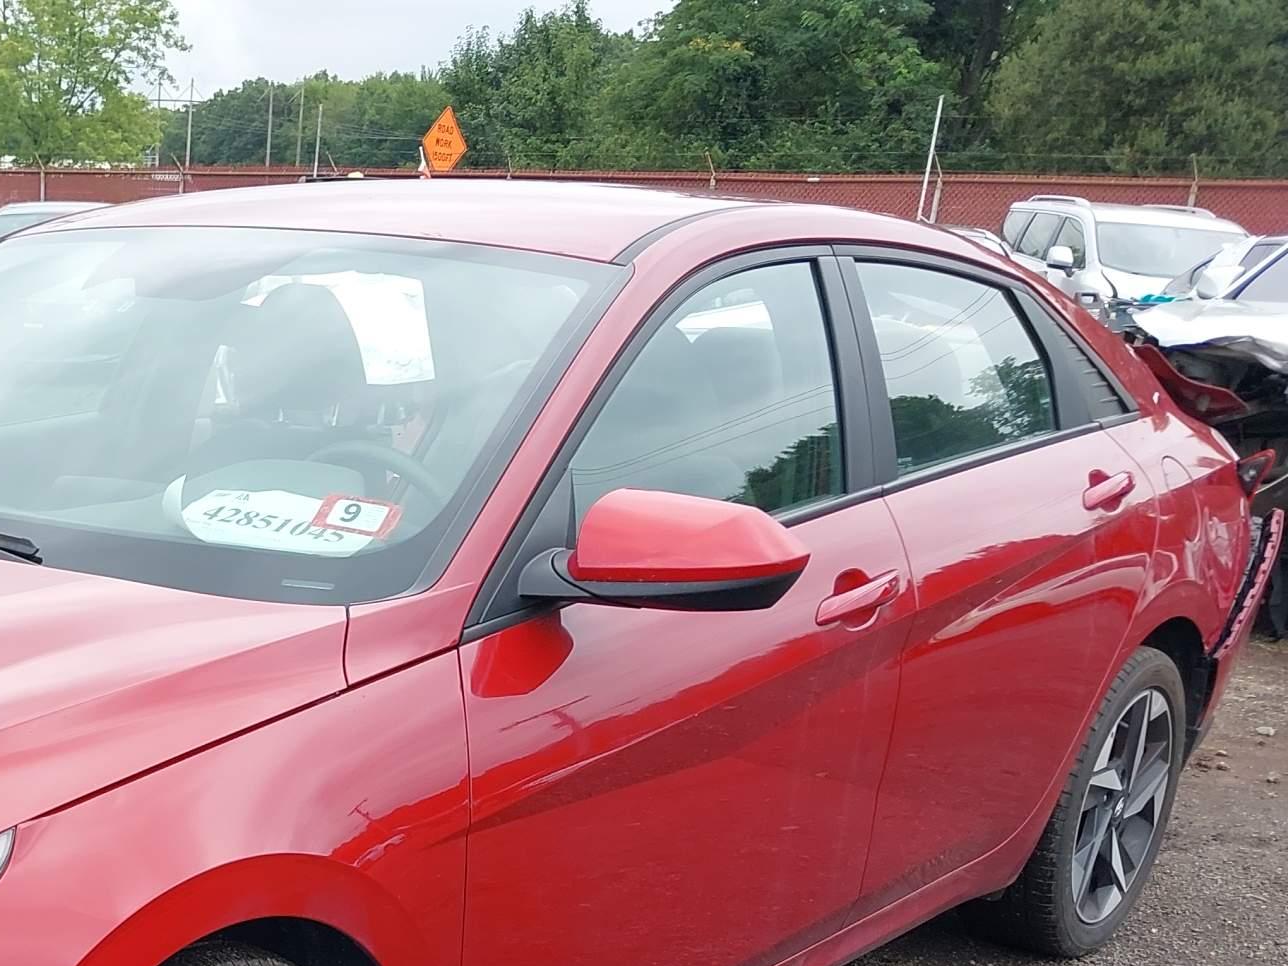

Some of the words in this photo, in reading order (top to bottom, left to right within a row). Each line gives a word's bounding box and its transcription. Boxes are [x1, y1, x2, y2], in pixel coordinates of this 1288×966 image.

[437, 123, 454, 135] ROAD
[435, 138, 452, 149] WORK
[339, 503, 362, 522] 9
